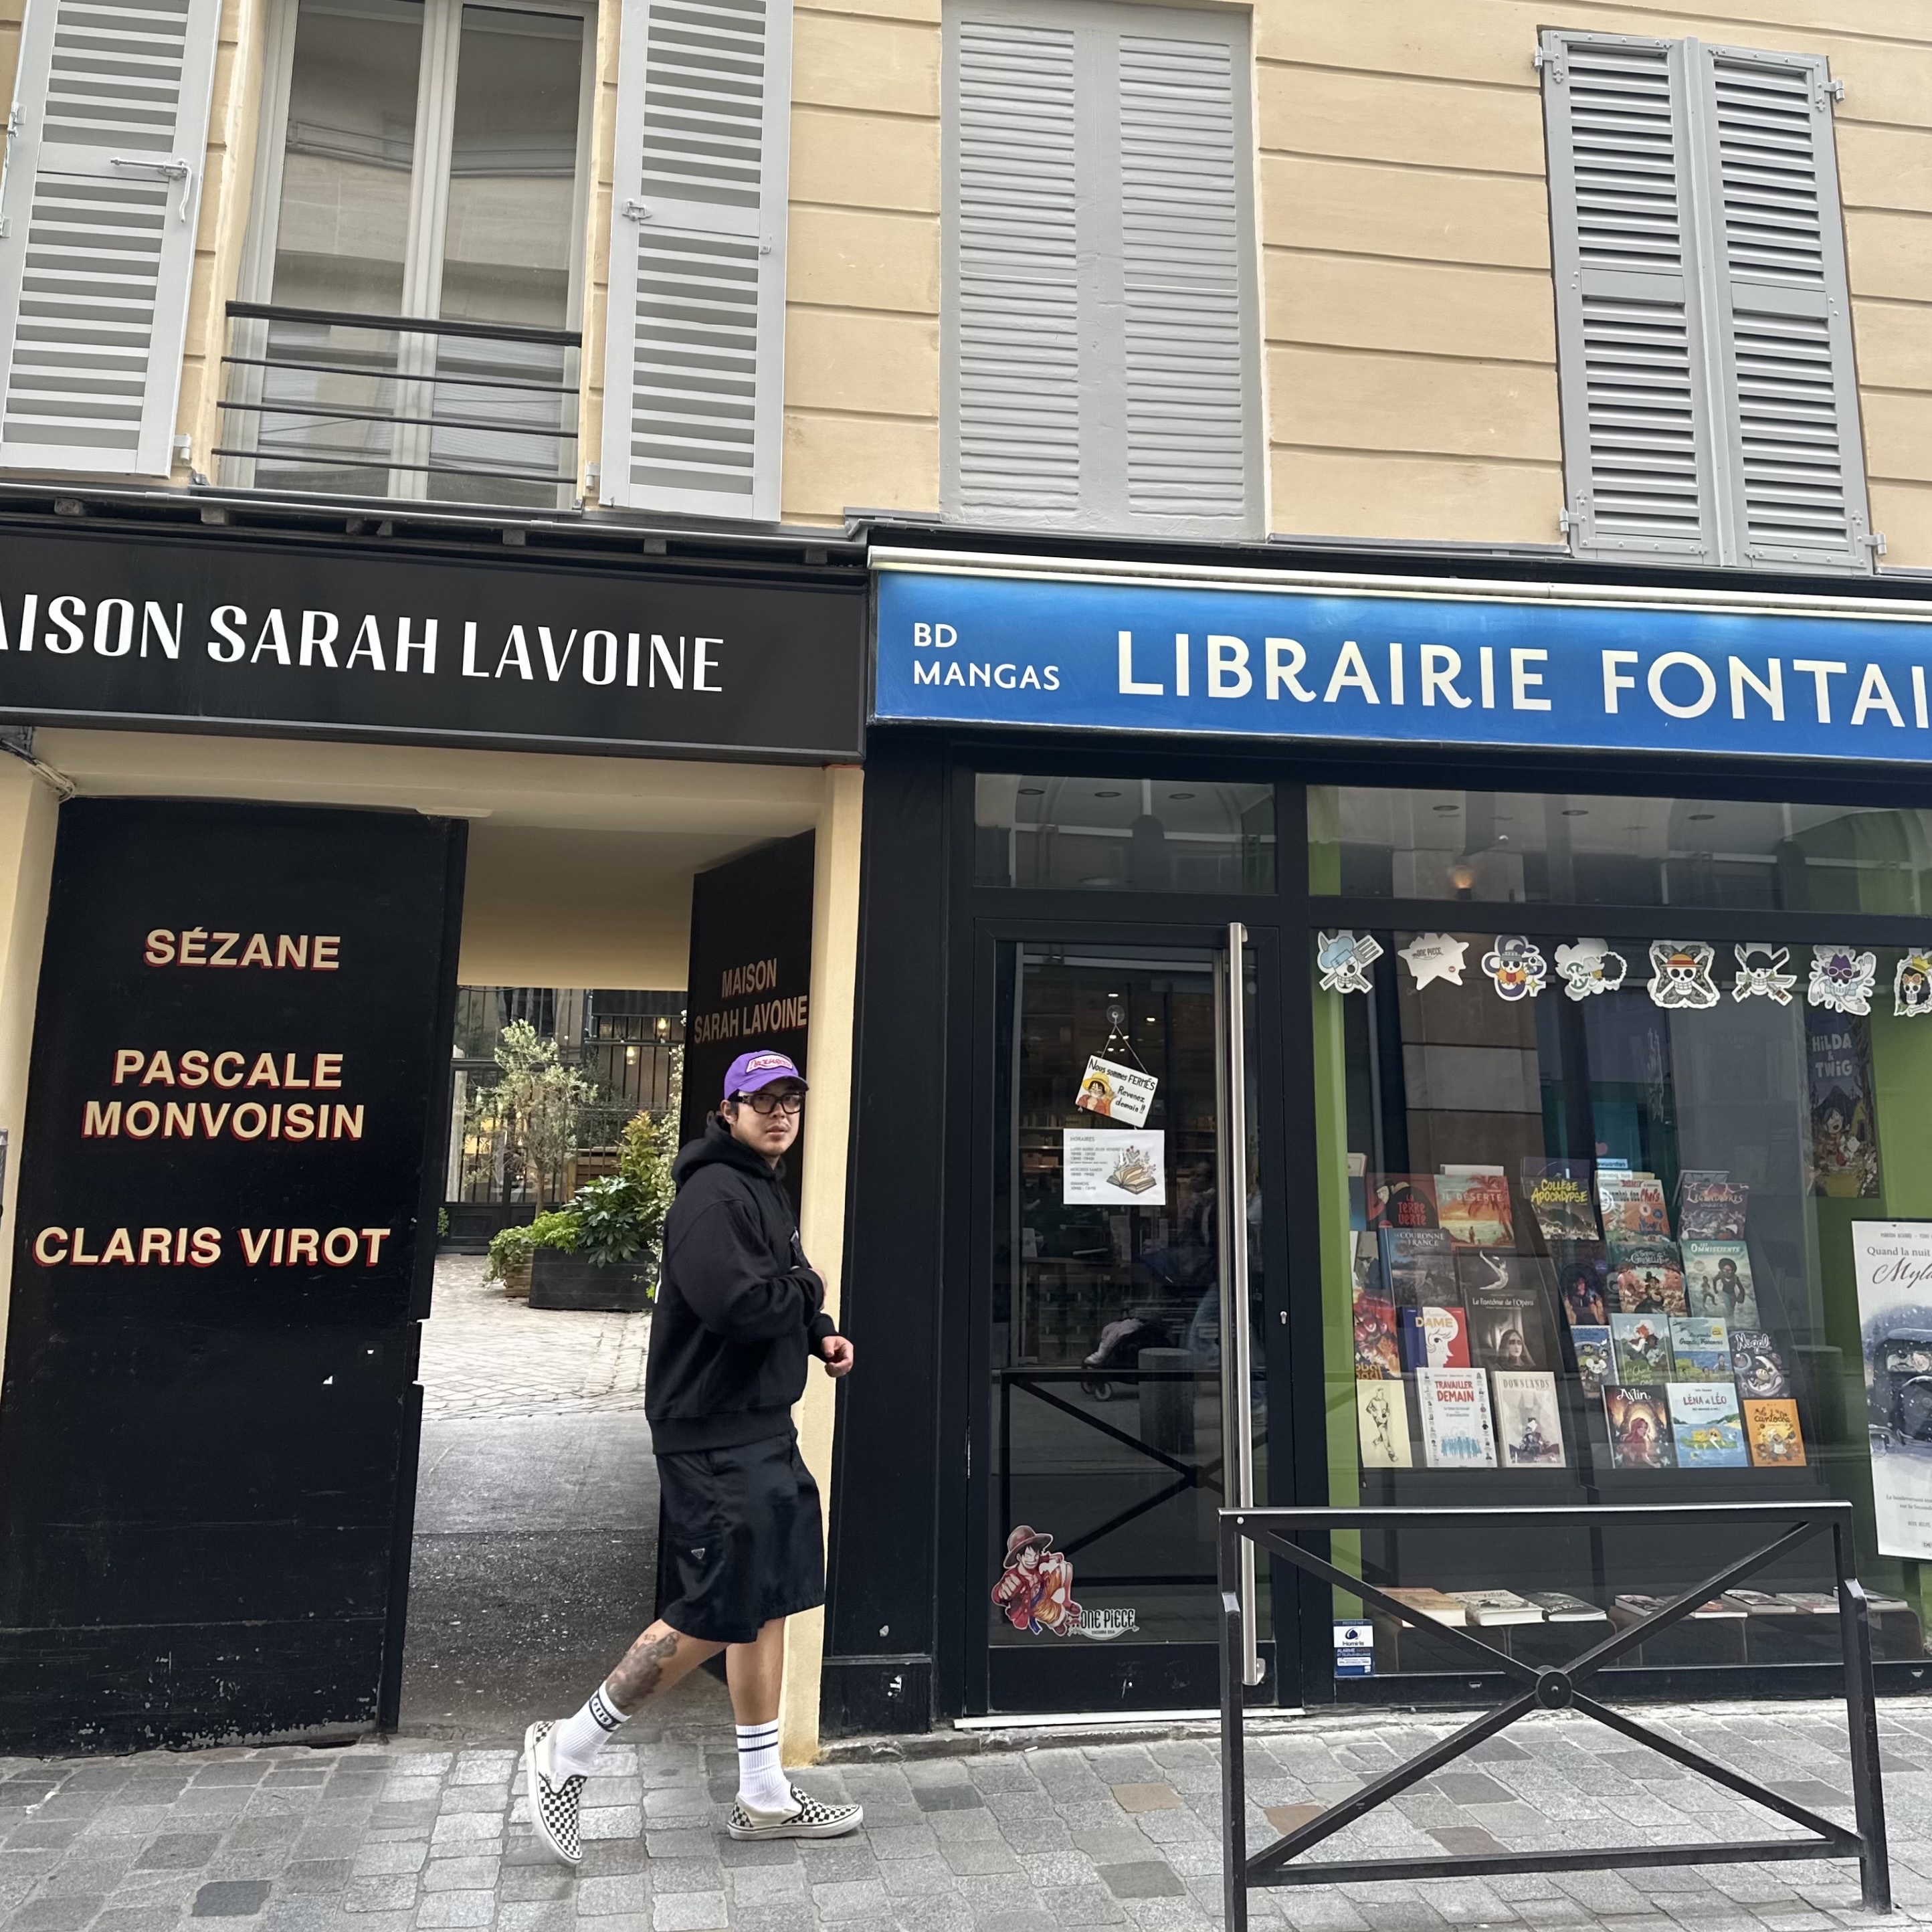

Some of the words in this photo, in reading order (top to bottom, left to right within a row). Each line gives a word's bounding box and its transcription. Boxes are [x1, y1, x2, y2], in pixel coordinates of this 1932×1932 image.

[913, 621, 958, 649] BD
[207, 604, 439, 674] SARAH
[461, 620, 724, 692] LAVOINE
[913, 660, 1061, 692] MANGAS
[1117, 630, 1553, 712] LIBRAIRIE
[1601, 649, 1930, 729] FONTAI
[144, 927, 342, 970] SÉZANE
[722, 958, 777, 998] MAISON
[694, 1008, 739, 1044] SARAH
[743, 995, 808, 1036] LAVOINE
[1828, 1051, 1834, 1060] &
[112, 1049, 345, 1088] PASCALE
[1088, 1058, 1106, 1074] Nous
[1106, 1069, 1129, 1081] sommes
[1117, 1086, 1145, 1103] Revenez
[1115, 1097, 1139, 1113] demain
[82, 1100, 365, 1141] MONVOISIN
[1531, 1187, 1588, 1205] APOCALYPSE
[1399, 1232, 1445, 1240] COURONNE
[1408, 1239, 1439, 1247] FRANCE
[33, 1226, 222, 1266] CLARIS
[238, 1227, 392, 1266] VIROT
[1691, 1244, 1741, 1253] OMNISCIENTS
[1867, 1246, 1899, 1256] Quand
[1901, 1247, 1909, 1256] la
[1912, 1248, 1931, 1256] nuit
[1480, 1298, 1504, 1306] Fantôme
[1415, 1317, 1454, 1328] DAME
[1435, 1381, 1473, 1389] TRAVAILLER
[1437, 1391, 1474, 1402] DEMAIN
[1616, 1388, 1651, 1404] Aylin
[1683, 1393, 1704, 1405] LÉNA
[1711, 1392, 1727, 1405] LÉO
